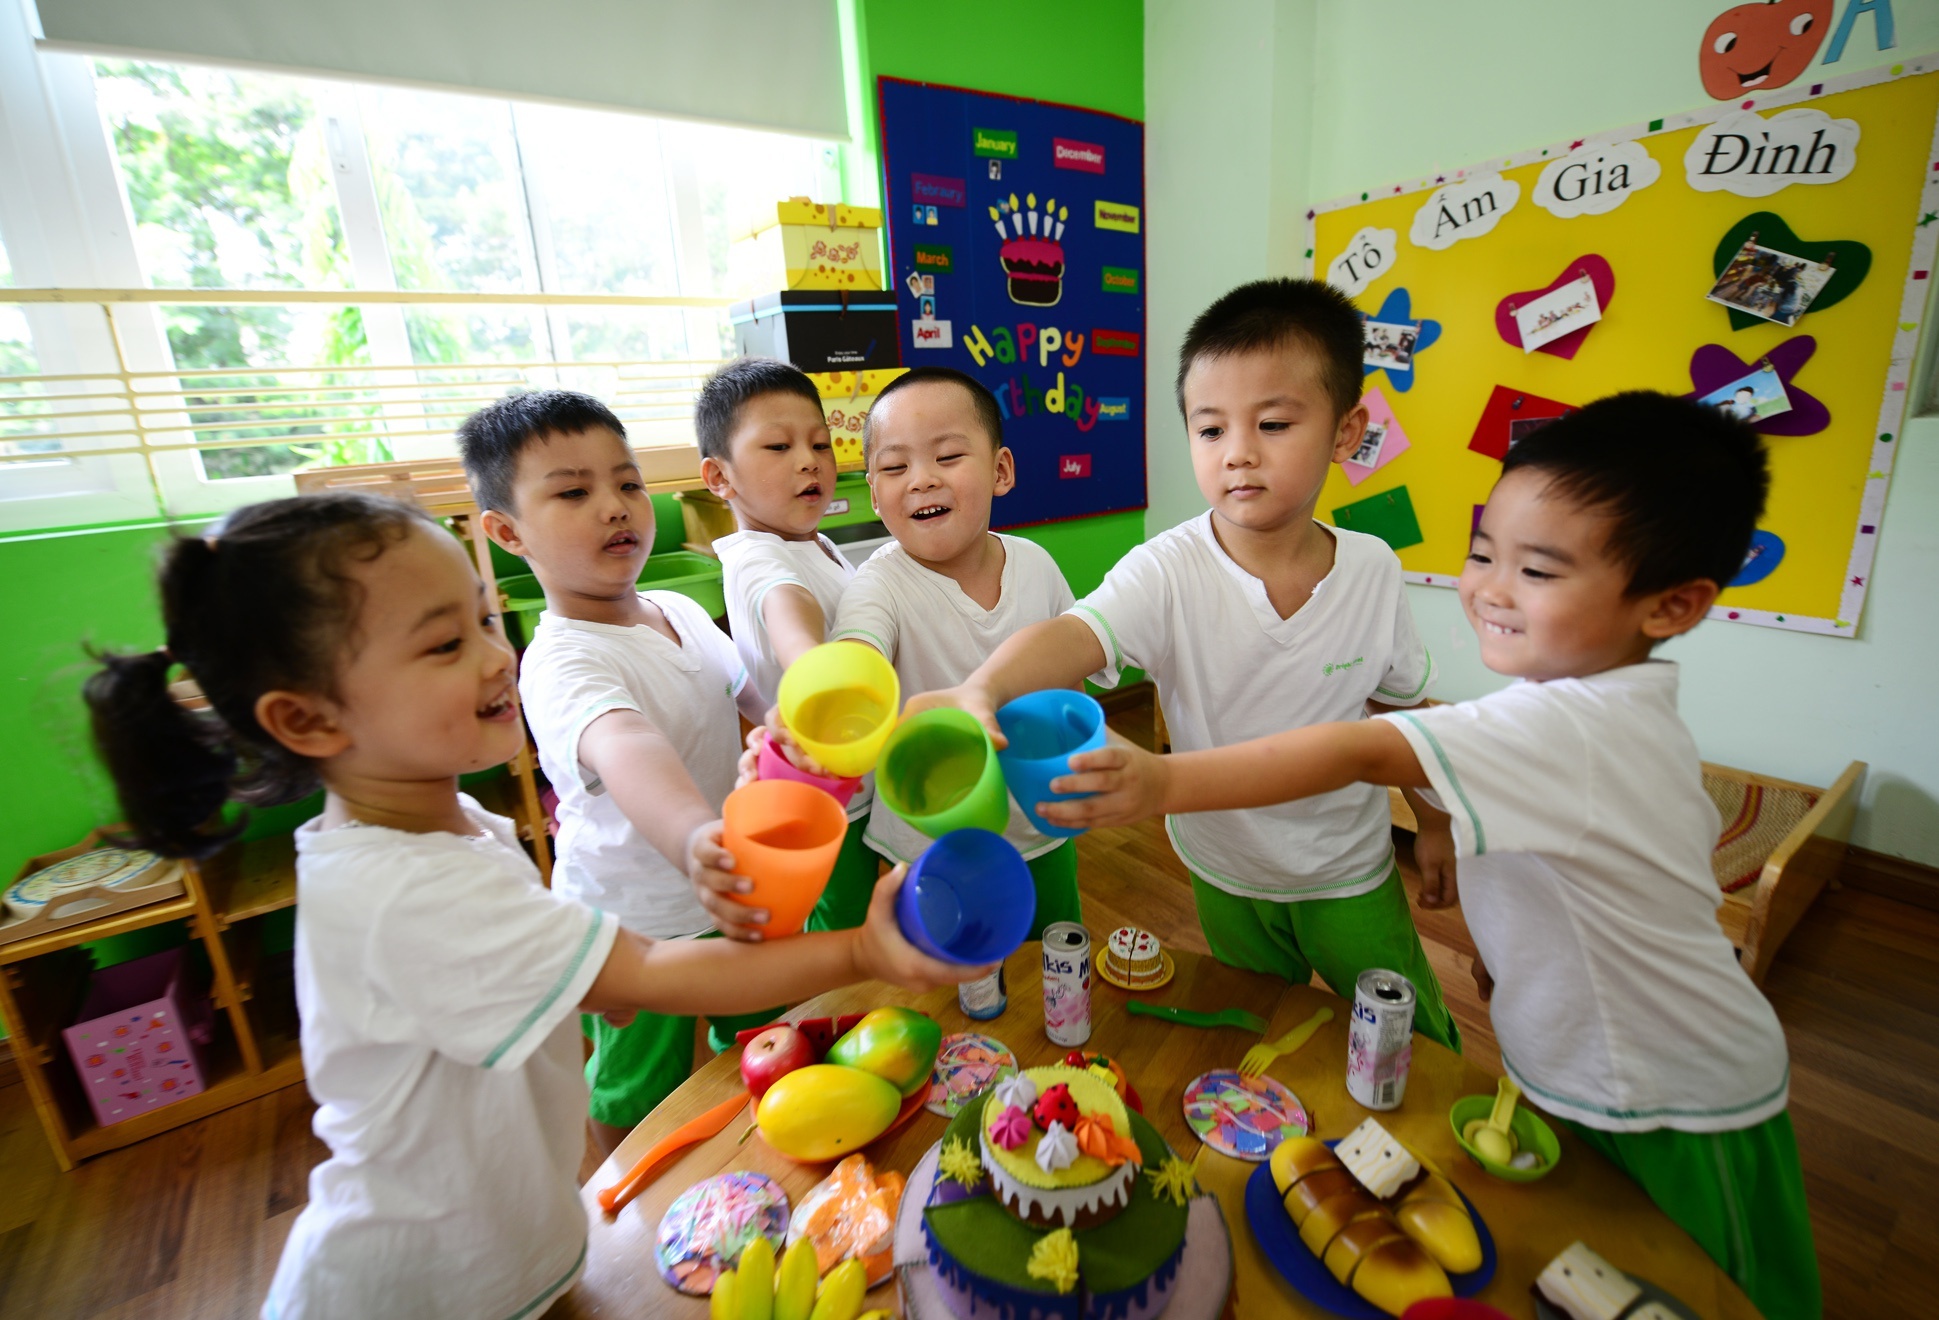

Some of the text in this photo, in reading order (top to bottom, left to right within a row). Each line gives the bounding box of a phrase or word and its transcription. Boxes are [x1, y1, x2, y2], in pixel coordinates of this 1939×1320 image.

[975, 131, 1016, 155] January
[1055, 145, 1103, 164] December
[1433, 190, 1499, 241] Ấm
[1553, 156, 1632, 202] Gia
[1697, 129, 1838, 176] Đình
[1098, 208, 1137, 223] November
[916, 251, 949, 266] March
[1104, 272, 1135, 287] October
[916, 326, 941, 342] April
[994, 371, 1101, 432] rthday
[1099, 403, 1127, 417] August
[1063, 460, 1082, 475] July
[1042, 951, 1073, 974] lkis
